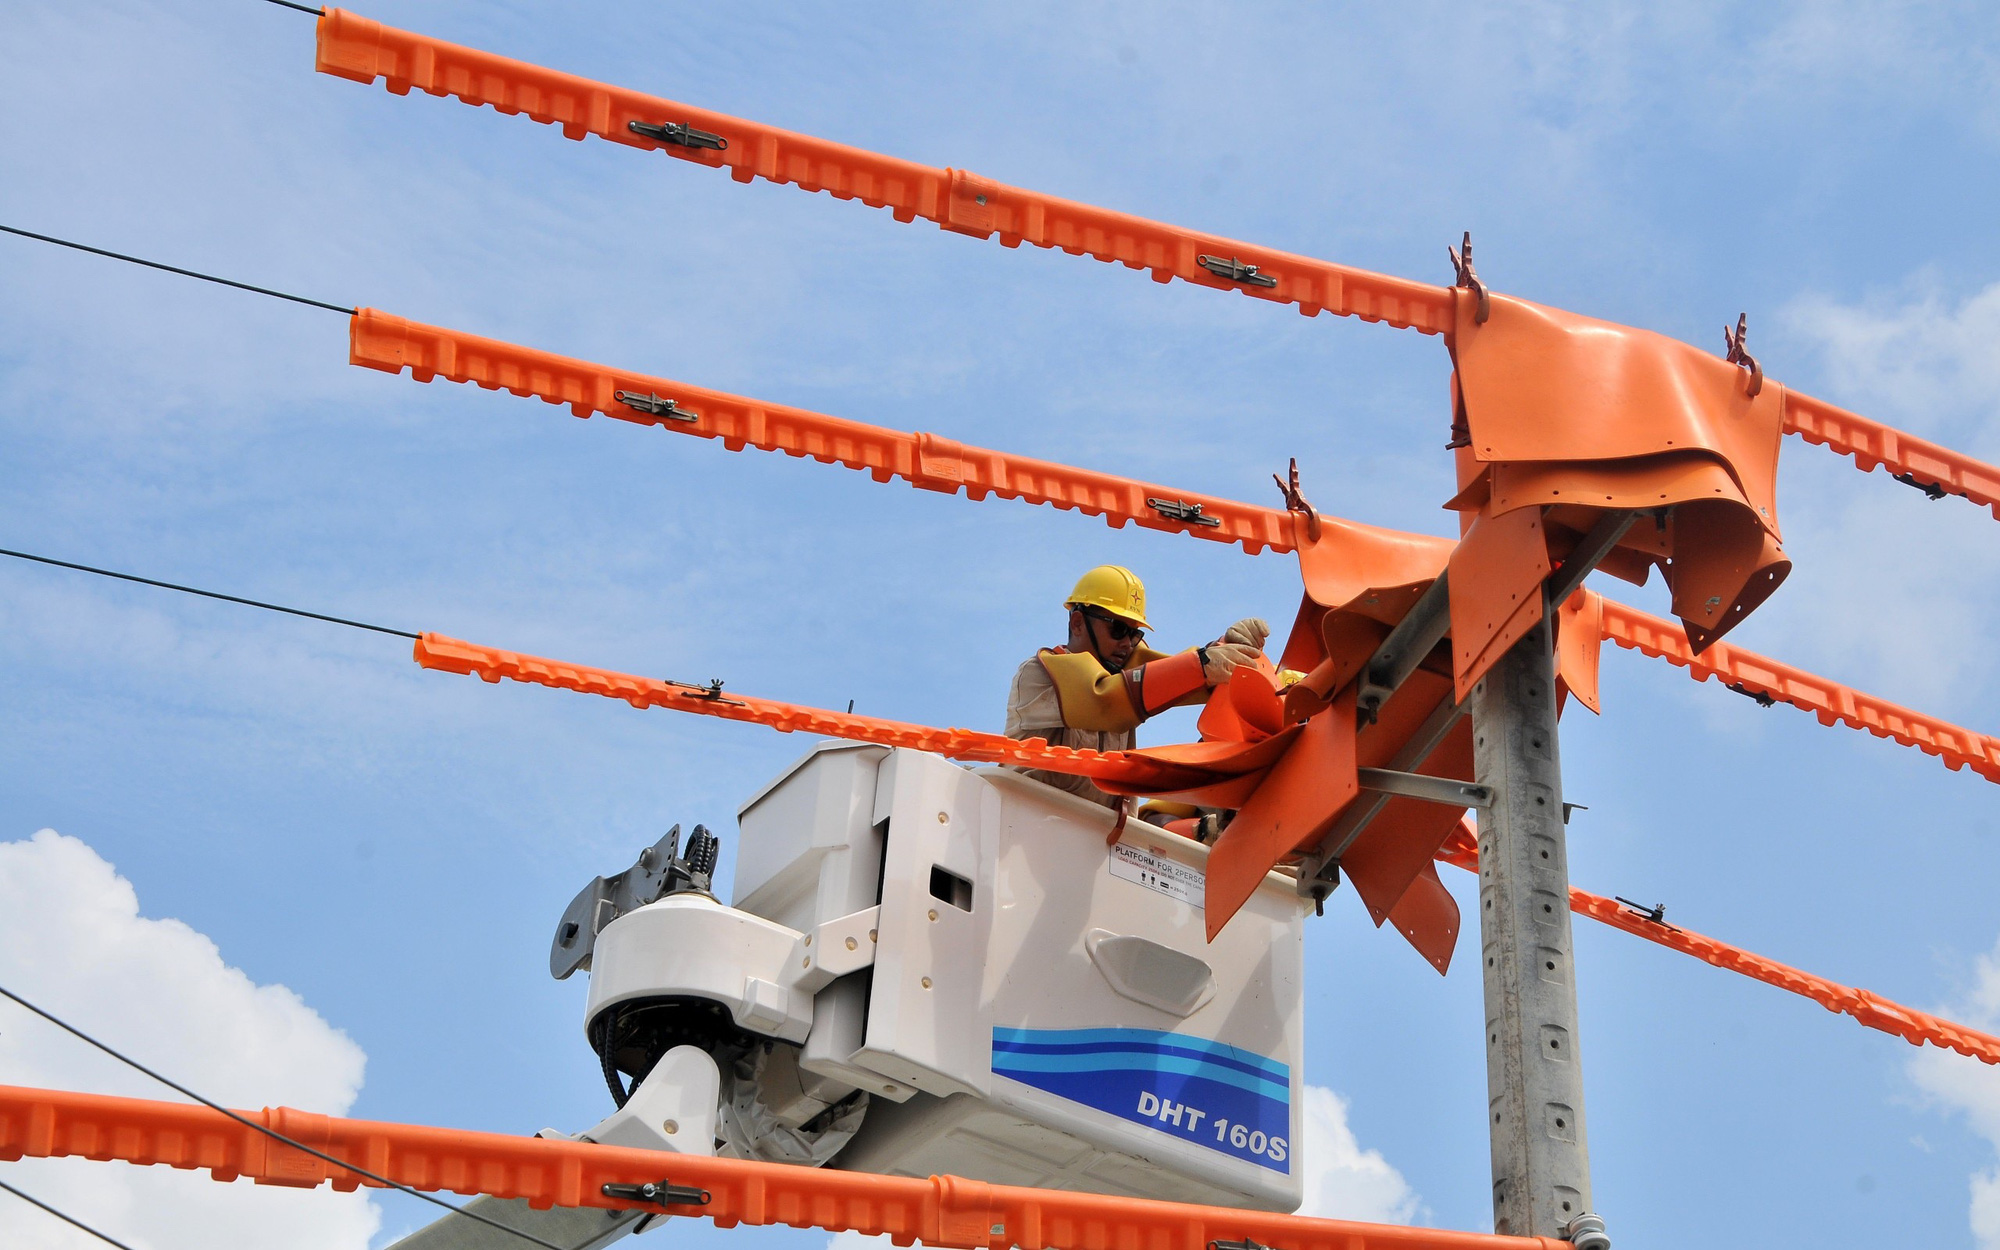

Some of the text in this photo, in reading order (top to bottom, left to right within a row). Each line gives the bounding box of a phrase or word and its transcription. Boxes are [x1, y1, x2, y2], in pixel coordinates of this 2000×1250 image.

[1115, 846, 1154, 866] PLATFORM
[1157, 862, 1172, 874] FOR
[1137, 1091, 1288, 1162] DHT 160S
